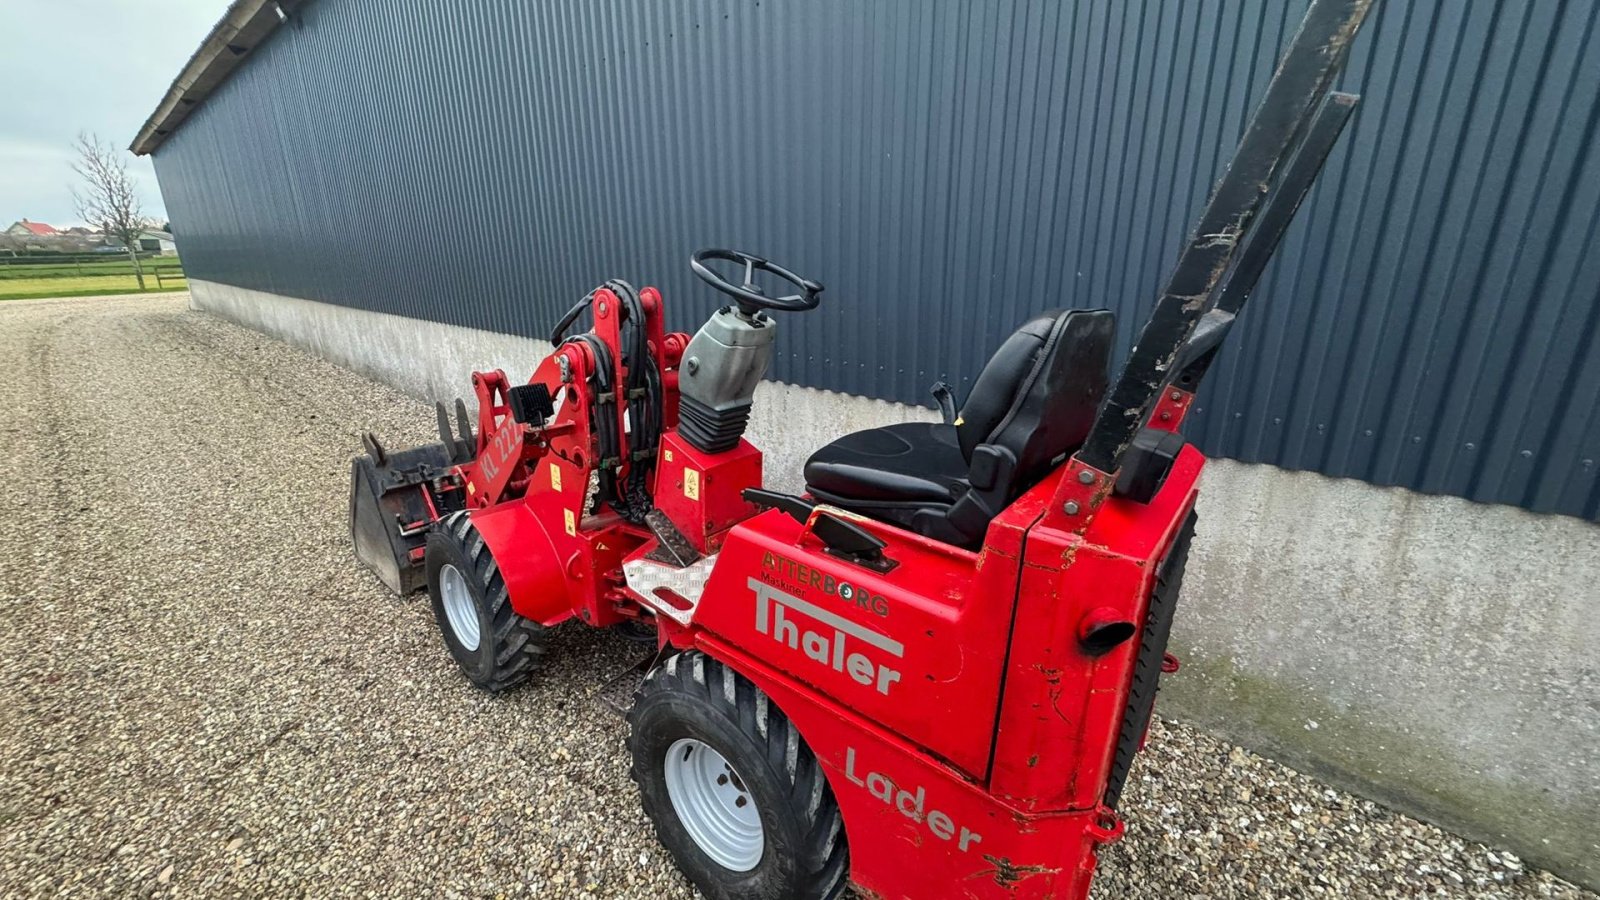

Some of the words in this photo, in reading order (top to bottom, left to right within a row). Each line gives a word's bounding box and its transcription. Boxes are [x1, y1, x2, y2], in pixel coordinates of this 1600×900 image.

[480, 452, 499, 483] KL
[761, 572, 807, 598] Maskiner
[762, 551, 889, 617] ATTERBORG
[747, 576, 904, 696] Thaler
[845, 746, 982, 852] Lader
